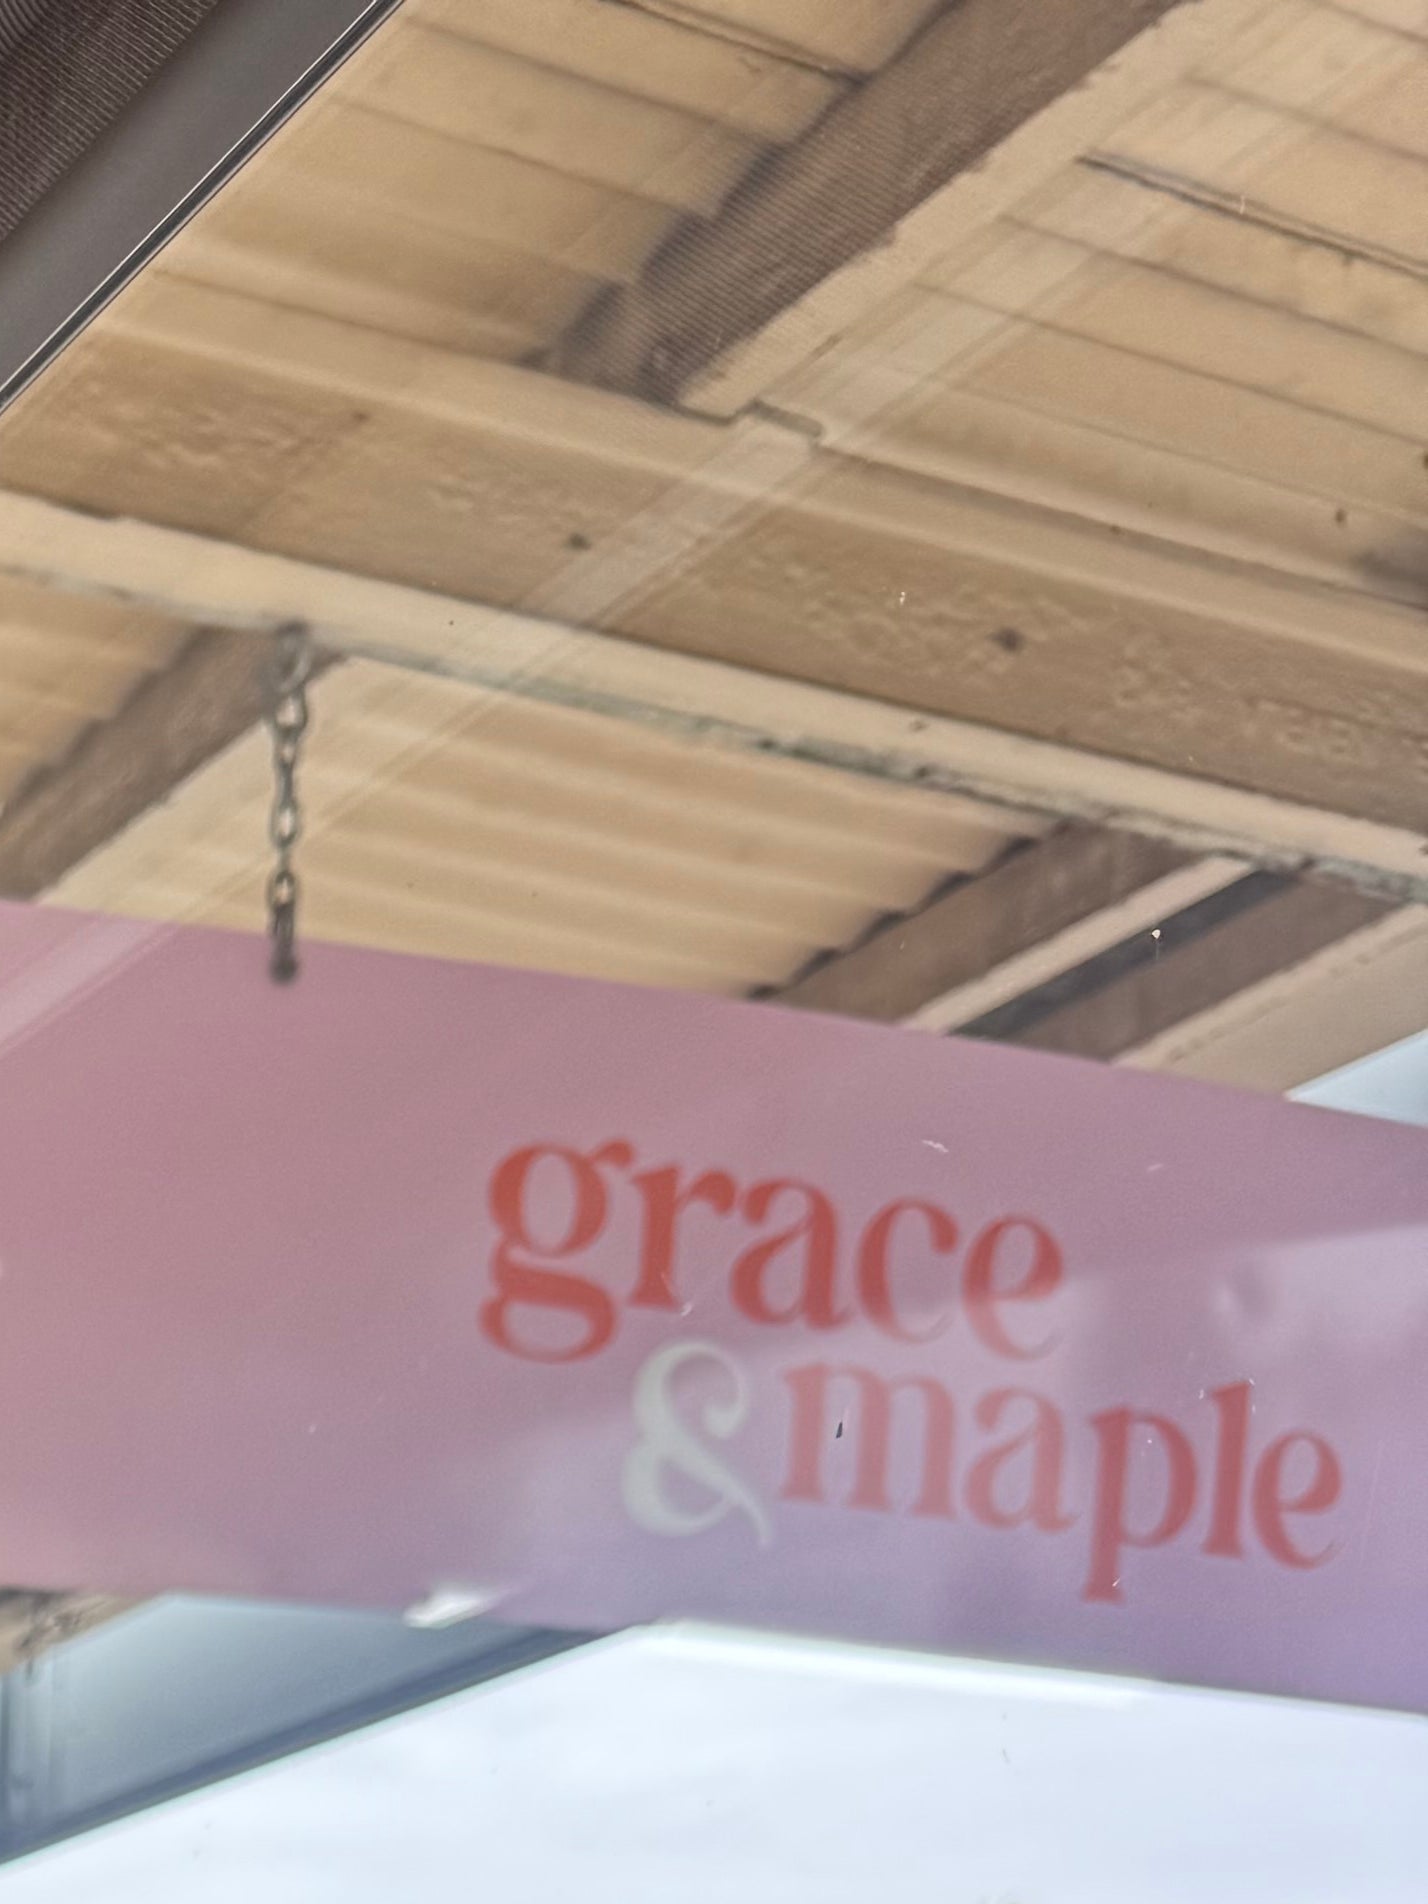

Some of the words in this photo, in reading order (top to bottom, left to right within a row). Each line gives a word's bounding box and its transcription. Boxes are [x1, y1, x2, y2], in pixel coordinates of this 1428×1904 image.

[478, 1138, 1064, 1362] grace
[620, 1340, 773, 1548] &
[779, 1360, 1341, 1602] maple
